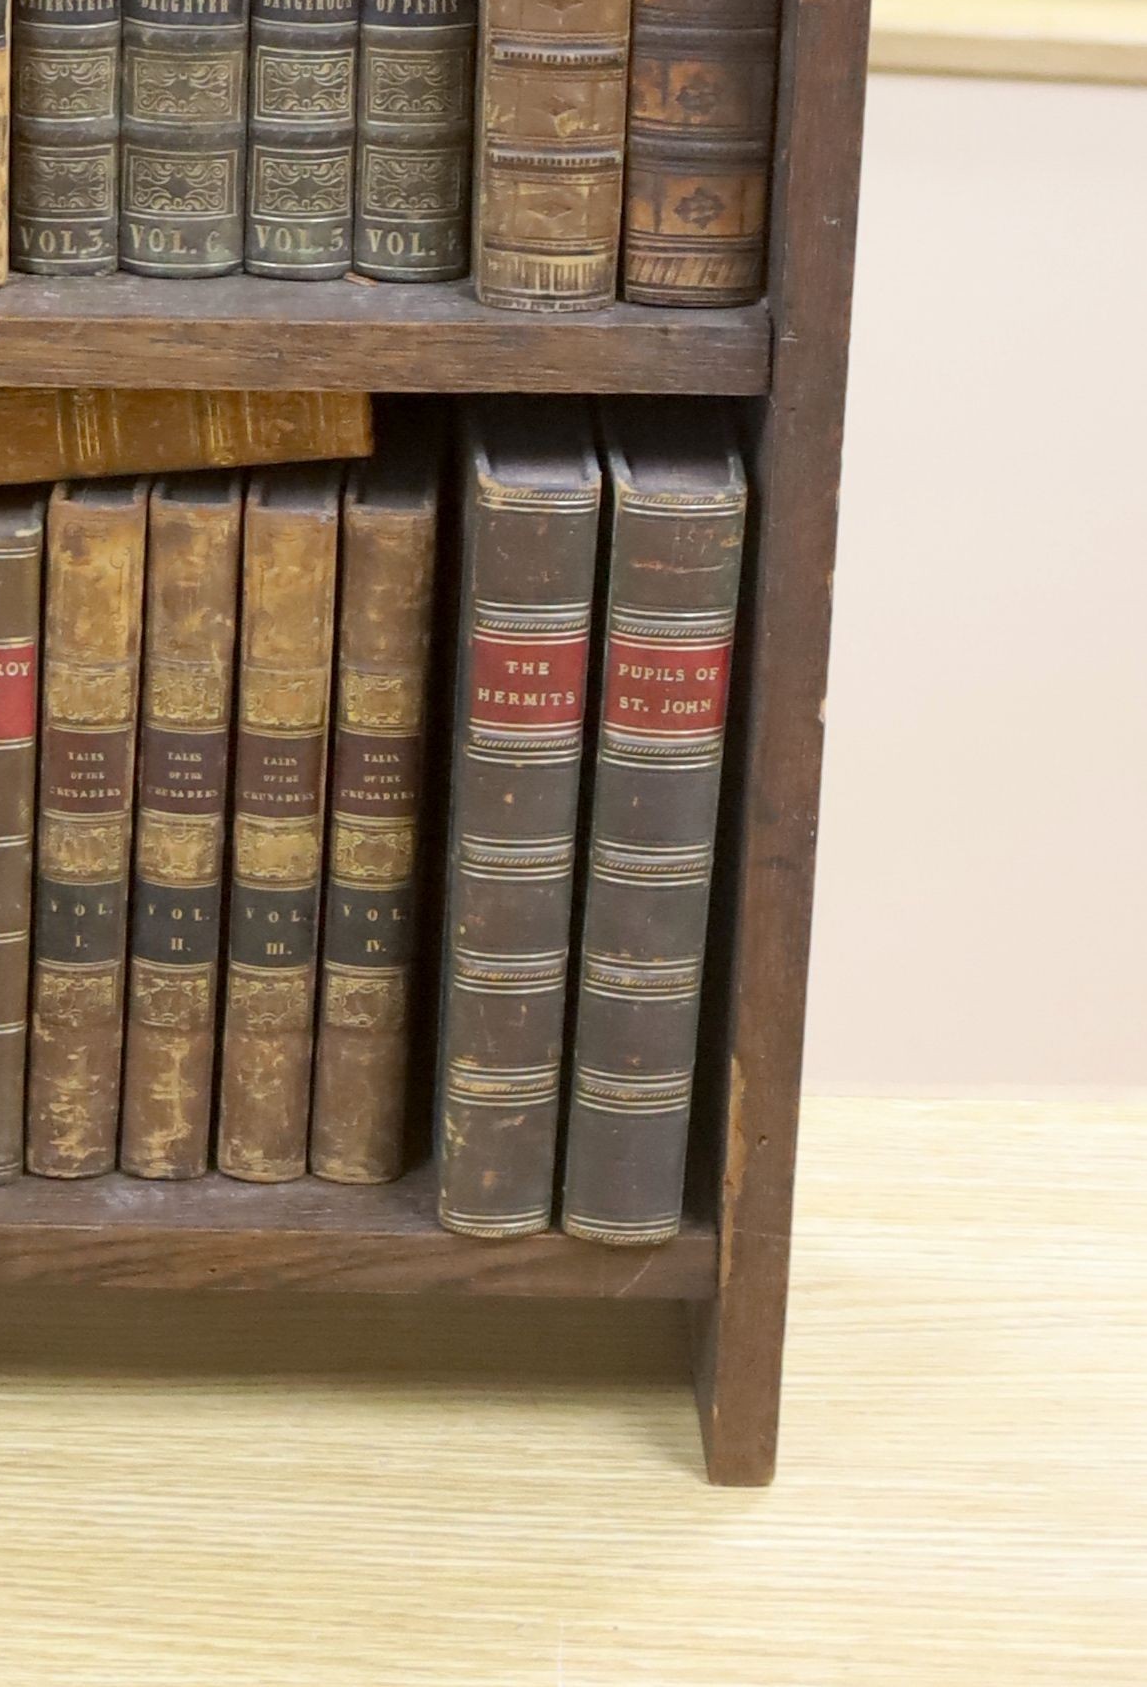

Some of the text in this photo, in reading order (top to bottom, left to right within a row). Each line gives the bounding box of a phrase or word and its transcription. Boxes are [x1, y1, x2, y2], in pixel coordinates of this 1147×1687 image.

[129, 223, 198, 254] VOL.
[254, 224, 324, 255] VOL.
[364, 228, 437, 257] VOL.
[505, 661, 550, 676] THE
[618, 663, 719, 682] PUPILS OF
[477, 688, 576, 706] HERMITS
[619, 696, 712, 714] ST. JOHN
[68, 752, 105, 762] TALES
[167, 752, 202, 762] TALES
[263, 757, 297, 767] TALES
[363, 753, 400, 763] TALES
[70, 771, 105, 780] OF THE
[169, 772, 203, 780] OF THE
[263, 775, 299, 783] OF THE
[364, 775, 402, 784] OF THE
[74, 935, 89, 949] I.
[170, 937, 192, 953] II.
[265, 941, 293, 956] III.
[365, 938, 388, 953] IV.
